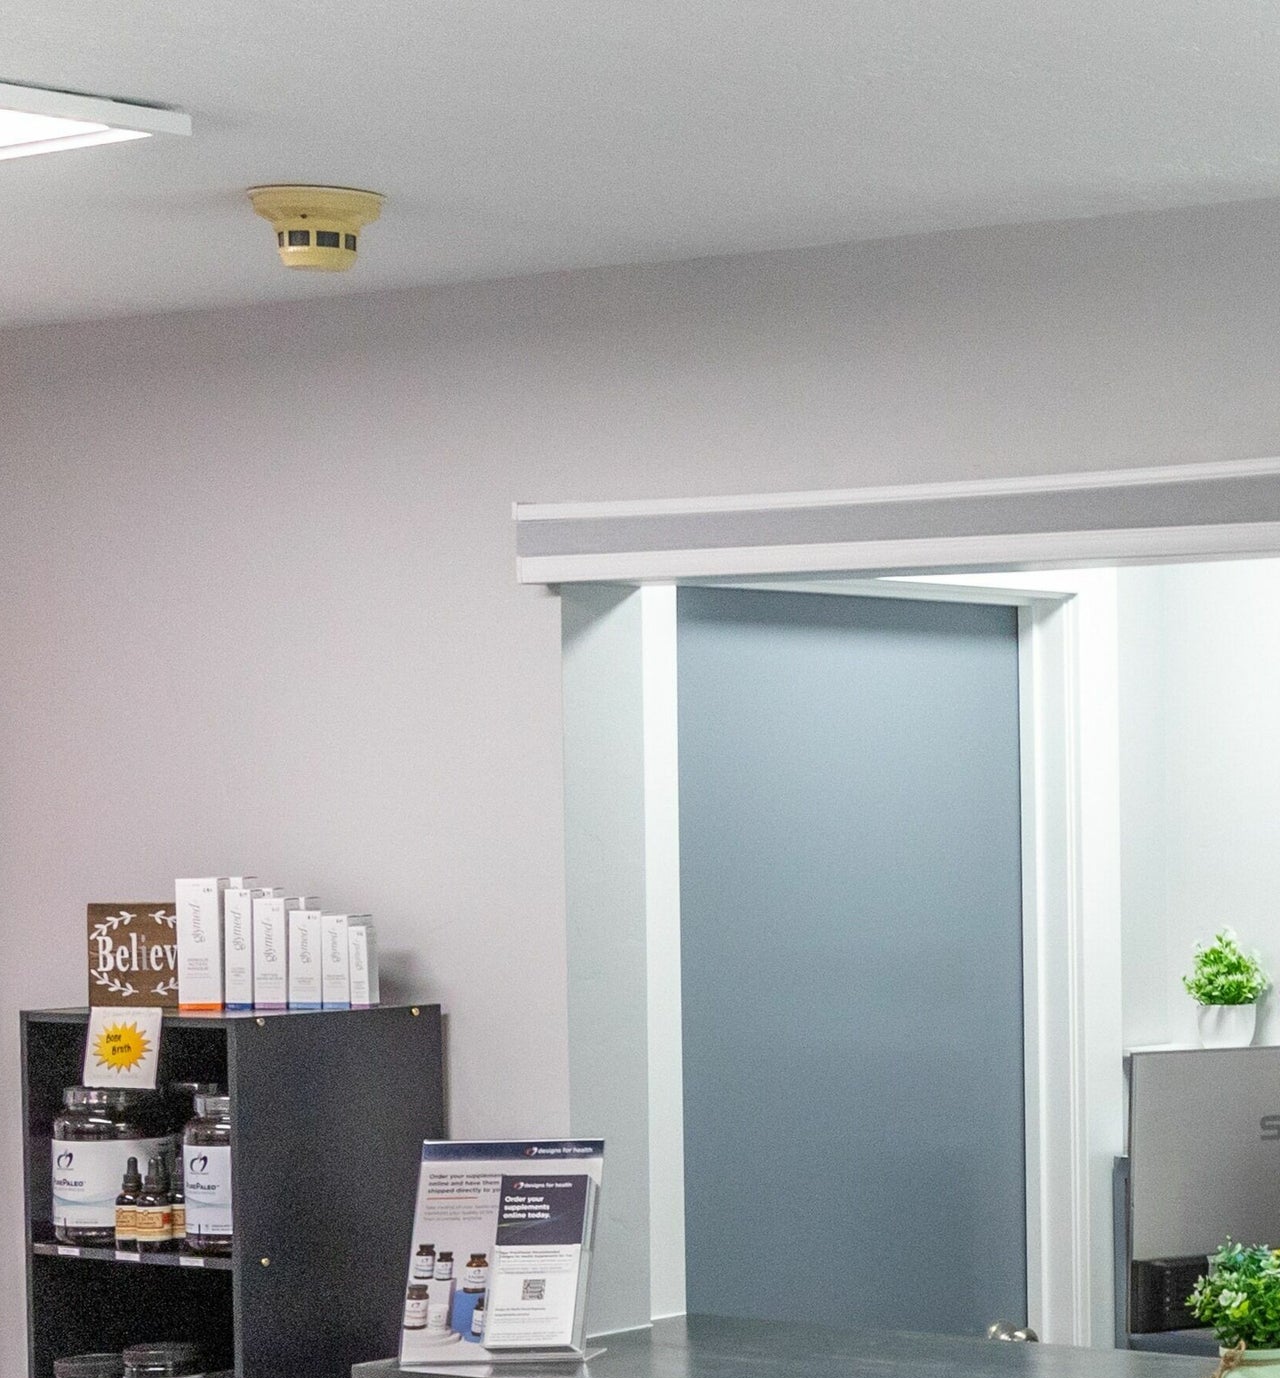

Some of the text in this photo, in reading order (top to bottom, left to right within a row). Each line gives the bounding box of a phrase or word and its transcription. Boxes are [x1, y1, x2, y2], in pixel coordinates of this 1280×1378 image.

[537, 1147, 562, 1155] designs
[455, 1186, 482, 1194] directly
[524, 1182, 545, 1190] designs
[504, 1195, 544, 1204] Order your
[503, 1203, 550, 1211] supplements
[527, 1212, 551, 1220] today.
